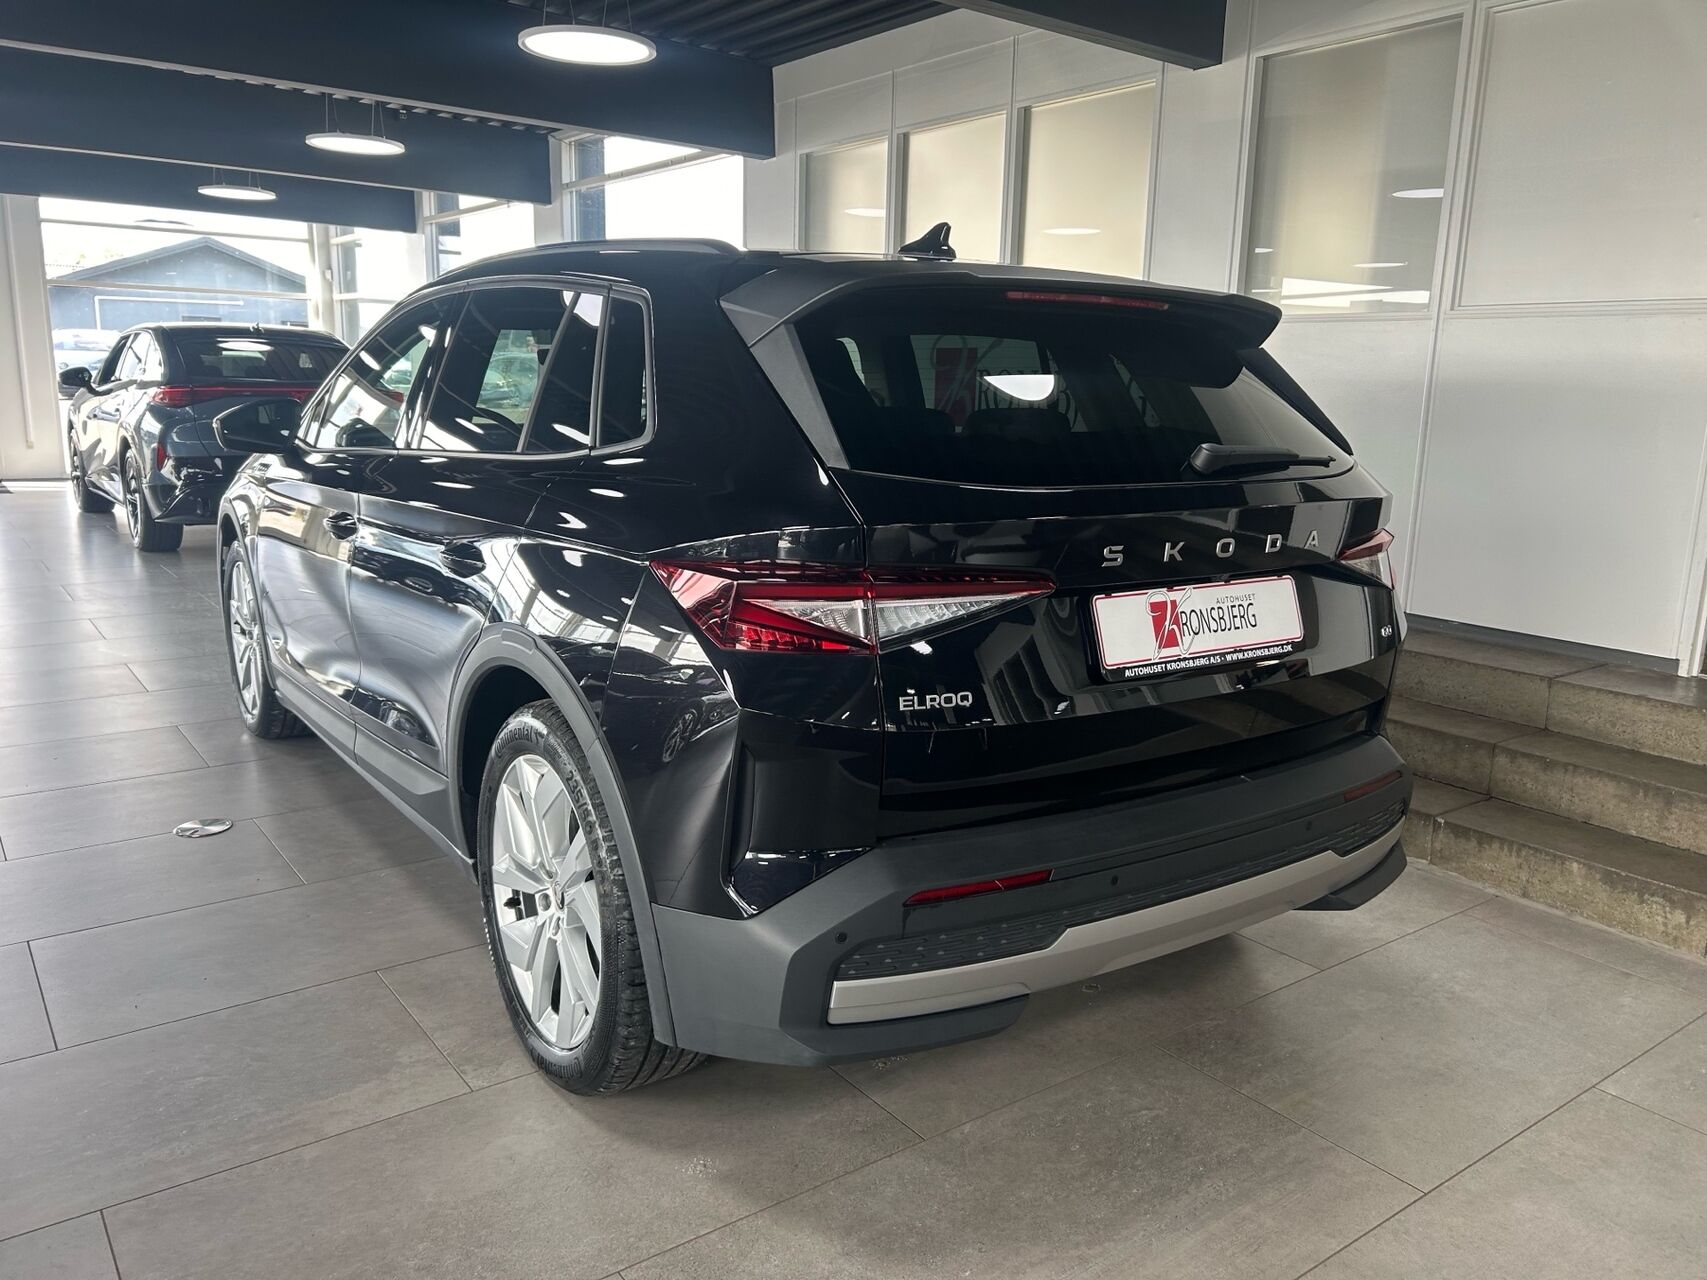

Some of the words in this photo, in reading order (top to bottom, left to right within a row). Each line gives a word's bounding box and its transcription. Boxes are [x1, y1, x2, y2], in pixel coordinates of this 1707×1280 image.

[1216, 593, 1256, 604] AUTOHUSET
[1125, 663, 1166, 677] AUTOHUSET
[1166, 657, 1209, 671] KRONSBJERG
[1210, 656, 1221, 665] A/S
[1225, 644, 1293, 662] WWW.KRONSBJERG.DK
[899, 691, 973, 711] ELROQ
[495, 726, 533, 758] Continental
